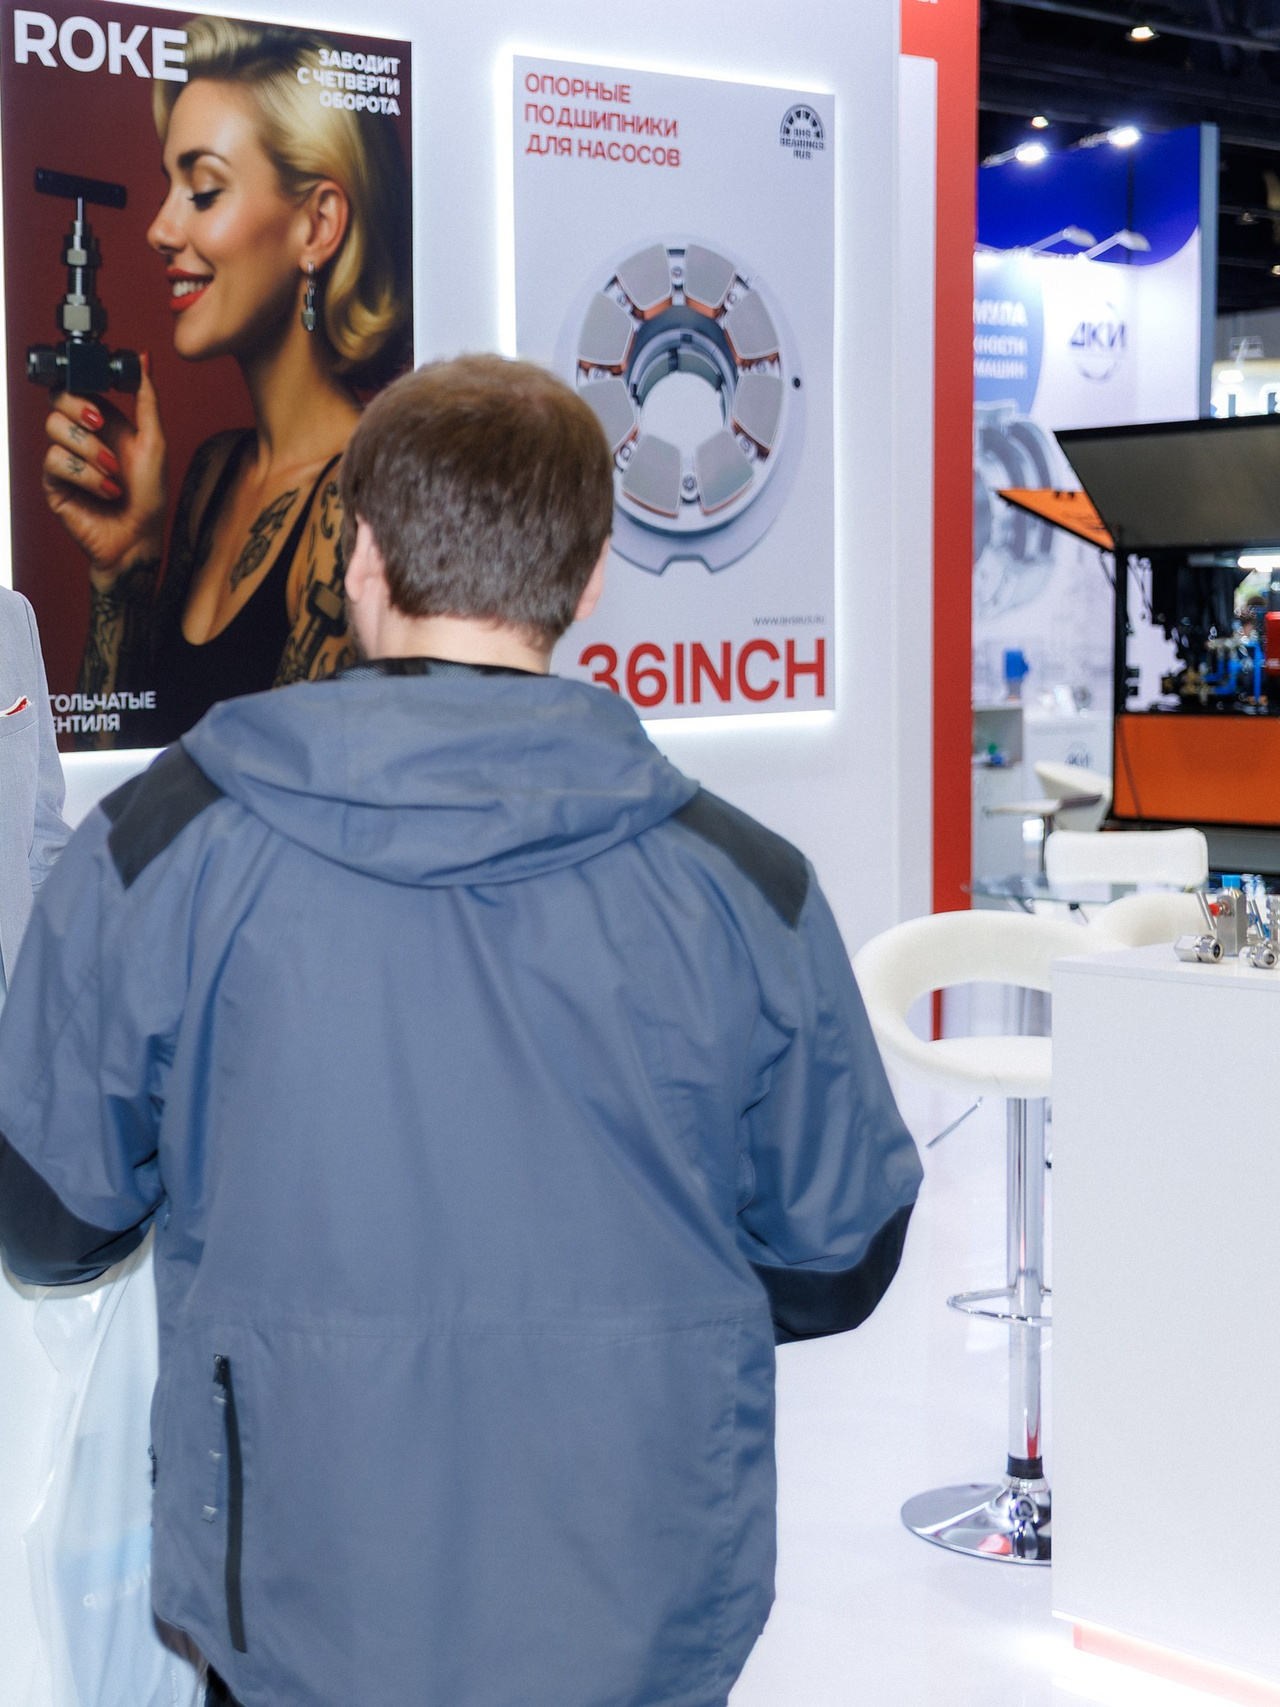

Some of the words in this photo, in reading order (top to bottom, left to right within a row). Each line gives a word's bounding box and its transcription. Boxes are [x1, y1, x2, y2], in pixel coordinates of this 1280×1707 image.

[13, 9, 188, 82] ROKE
[318, 48, 401, 75] ЗАВОДИТ
[297, 67, 311, 85] С
[312, 68, 400, 96] ЧЕТВЕРТИ
[524, 73, 631, 104] ОПОРНЫЕ
[320, 90, 401, 116] ОБОРОТА
[524, 103, 678, 138] ПОДШИПНИКИ
[525, 134, 573, 157] ДЛЯ
[576, 140, 681, 168] НАСОСОВ
[578, 638, 826, 708] 36INCH
